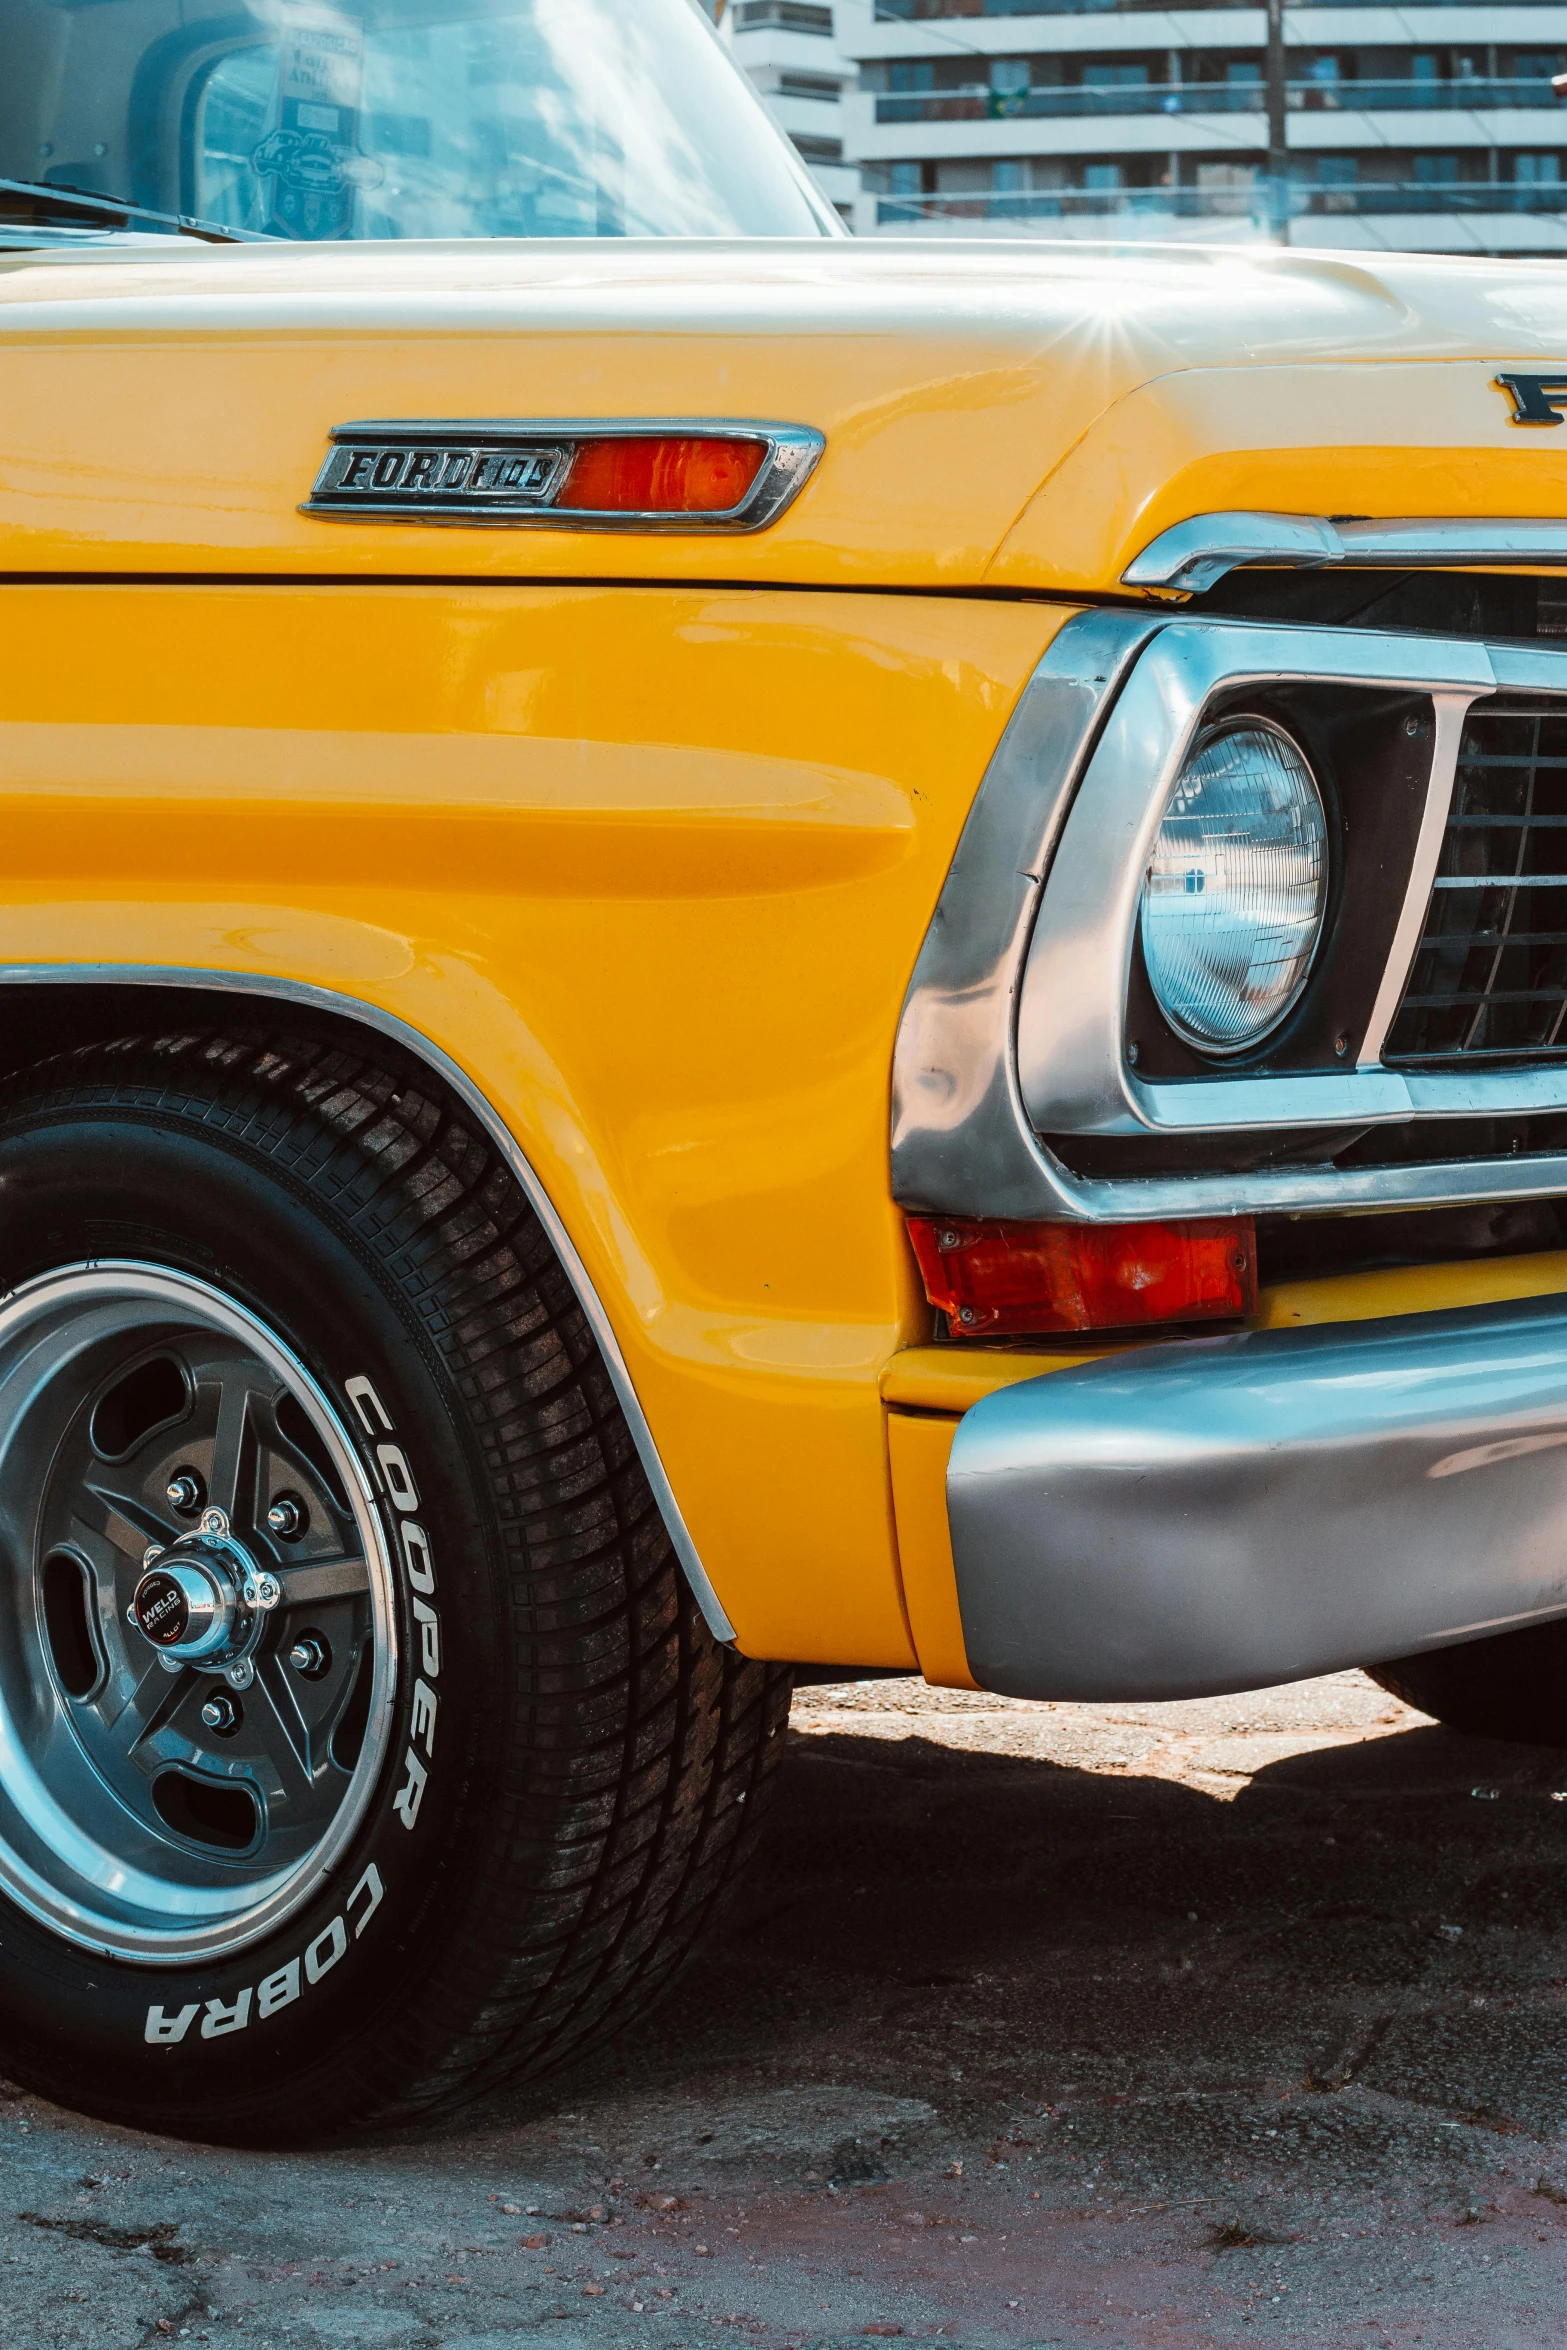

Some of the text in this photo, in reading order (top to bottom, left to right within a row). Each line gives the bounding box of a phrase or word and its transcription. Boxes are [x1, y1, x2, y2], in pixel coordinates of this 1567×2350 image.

[336, 451, 475, 489] FORD
[142, 1590, 177, 1623] WELD
[146, 1598, 181, 1630] RACING
[163, 1621, 181, 1638] ALLOY
[144, 1375, 440, 2044] COOPER COBRA
